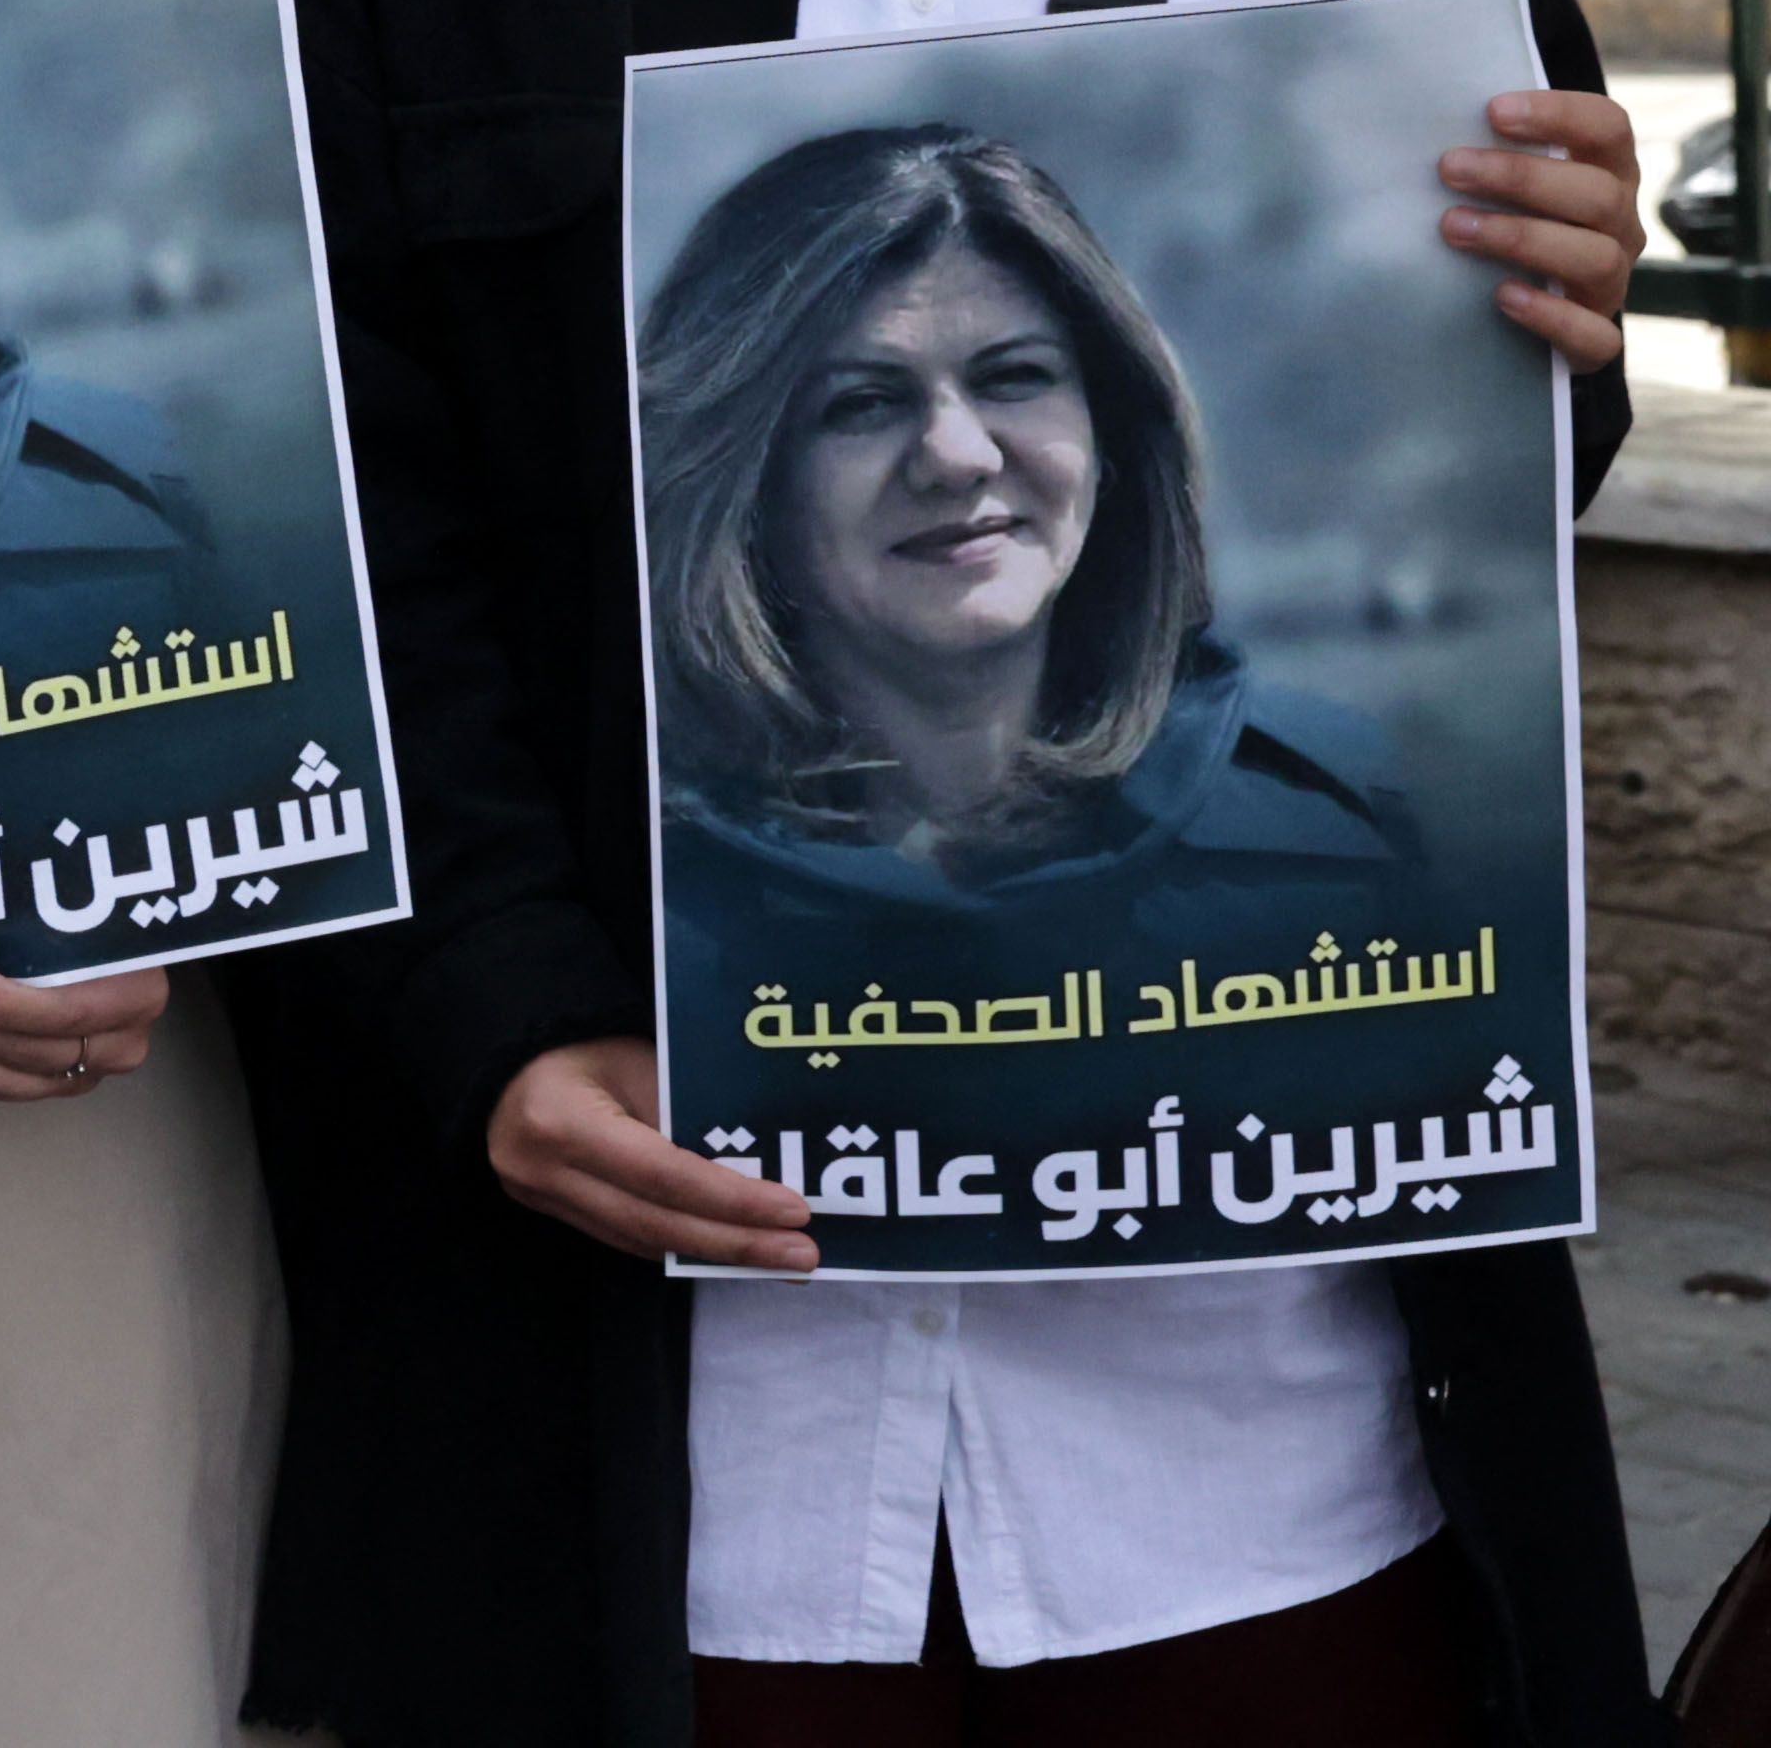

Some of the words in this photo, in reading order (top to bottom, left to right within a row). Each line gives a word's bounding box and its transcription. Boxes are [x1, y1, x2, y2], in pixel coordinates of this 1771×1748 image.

[31, 739, 370, 934] شيرين
[743, 969, 1104, 1070] الصحفية
[1127, 926, 1496, 1034] استشهاد
[1031, 1094, 1185, 1242] أبو
[1209, 1053, 1558, 1226] شيرين
